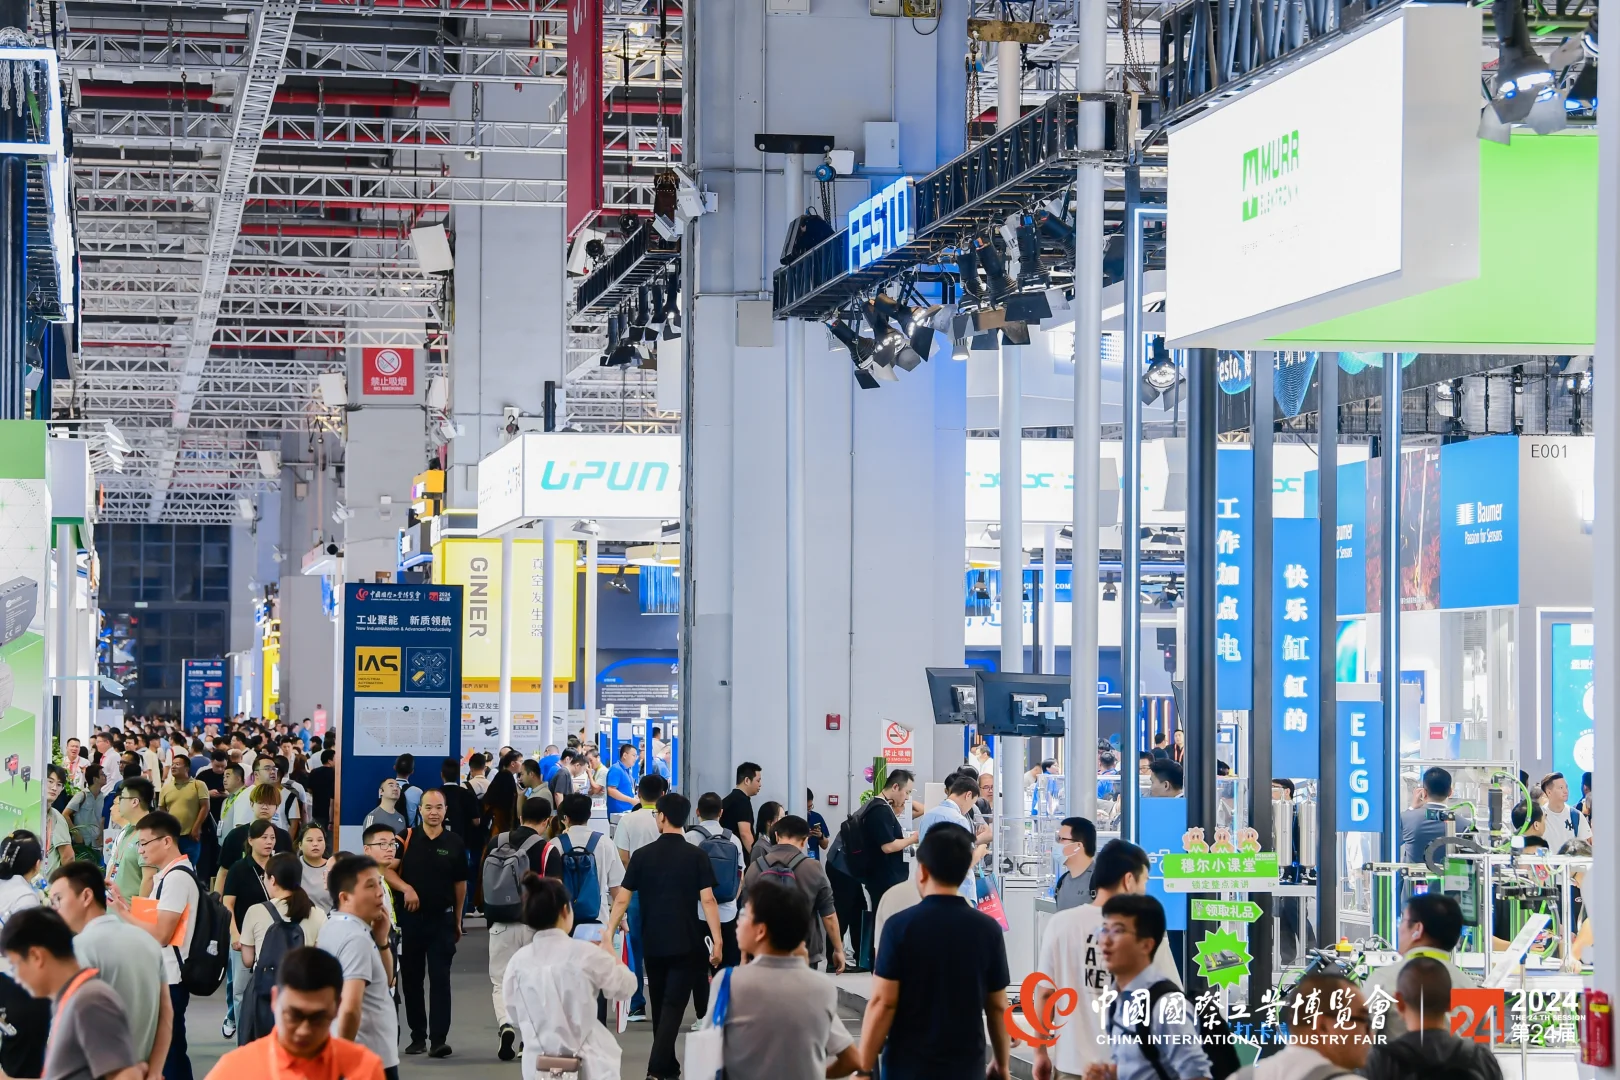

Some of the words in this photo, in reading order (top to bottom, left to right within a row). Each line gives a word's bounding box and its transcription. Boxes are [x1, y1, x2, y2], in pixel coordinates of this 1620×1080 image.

[848, 176, 908, 275] FESTO
[1531, 443, 1568, 459] E001
[1477, 501, 1503, 524] Baumer
[1336, 523, 1353, 541] aumer
[469, 557, 489, 638] GINIER
[356, 615, 399, 626] 工业聚能
[409, 615, 452, 627] 新质领航
[1282, 564, 1310, 732] 快乐缸缸的
[358, 655, 399, 672] IAS
[1349, 711, 1370, 821] ELGD
[1181, 857, 1257, 873] 穆尔小课堂
[1205, 903, 1254, 919] 领取礼品
